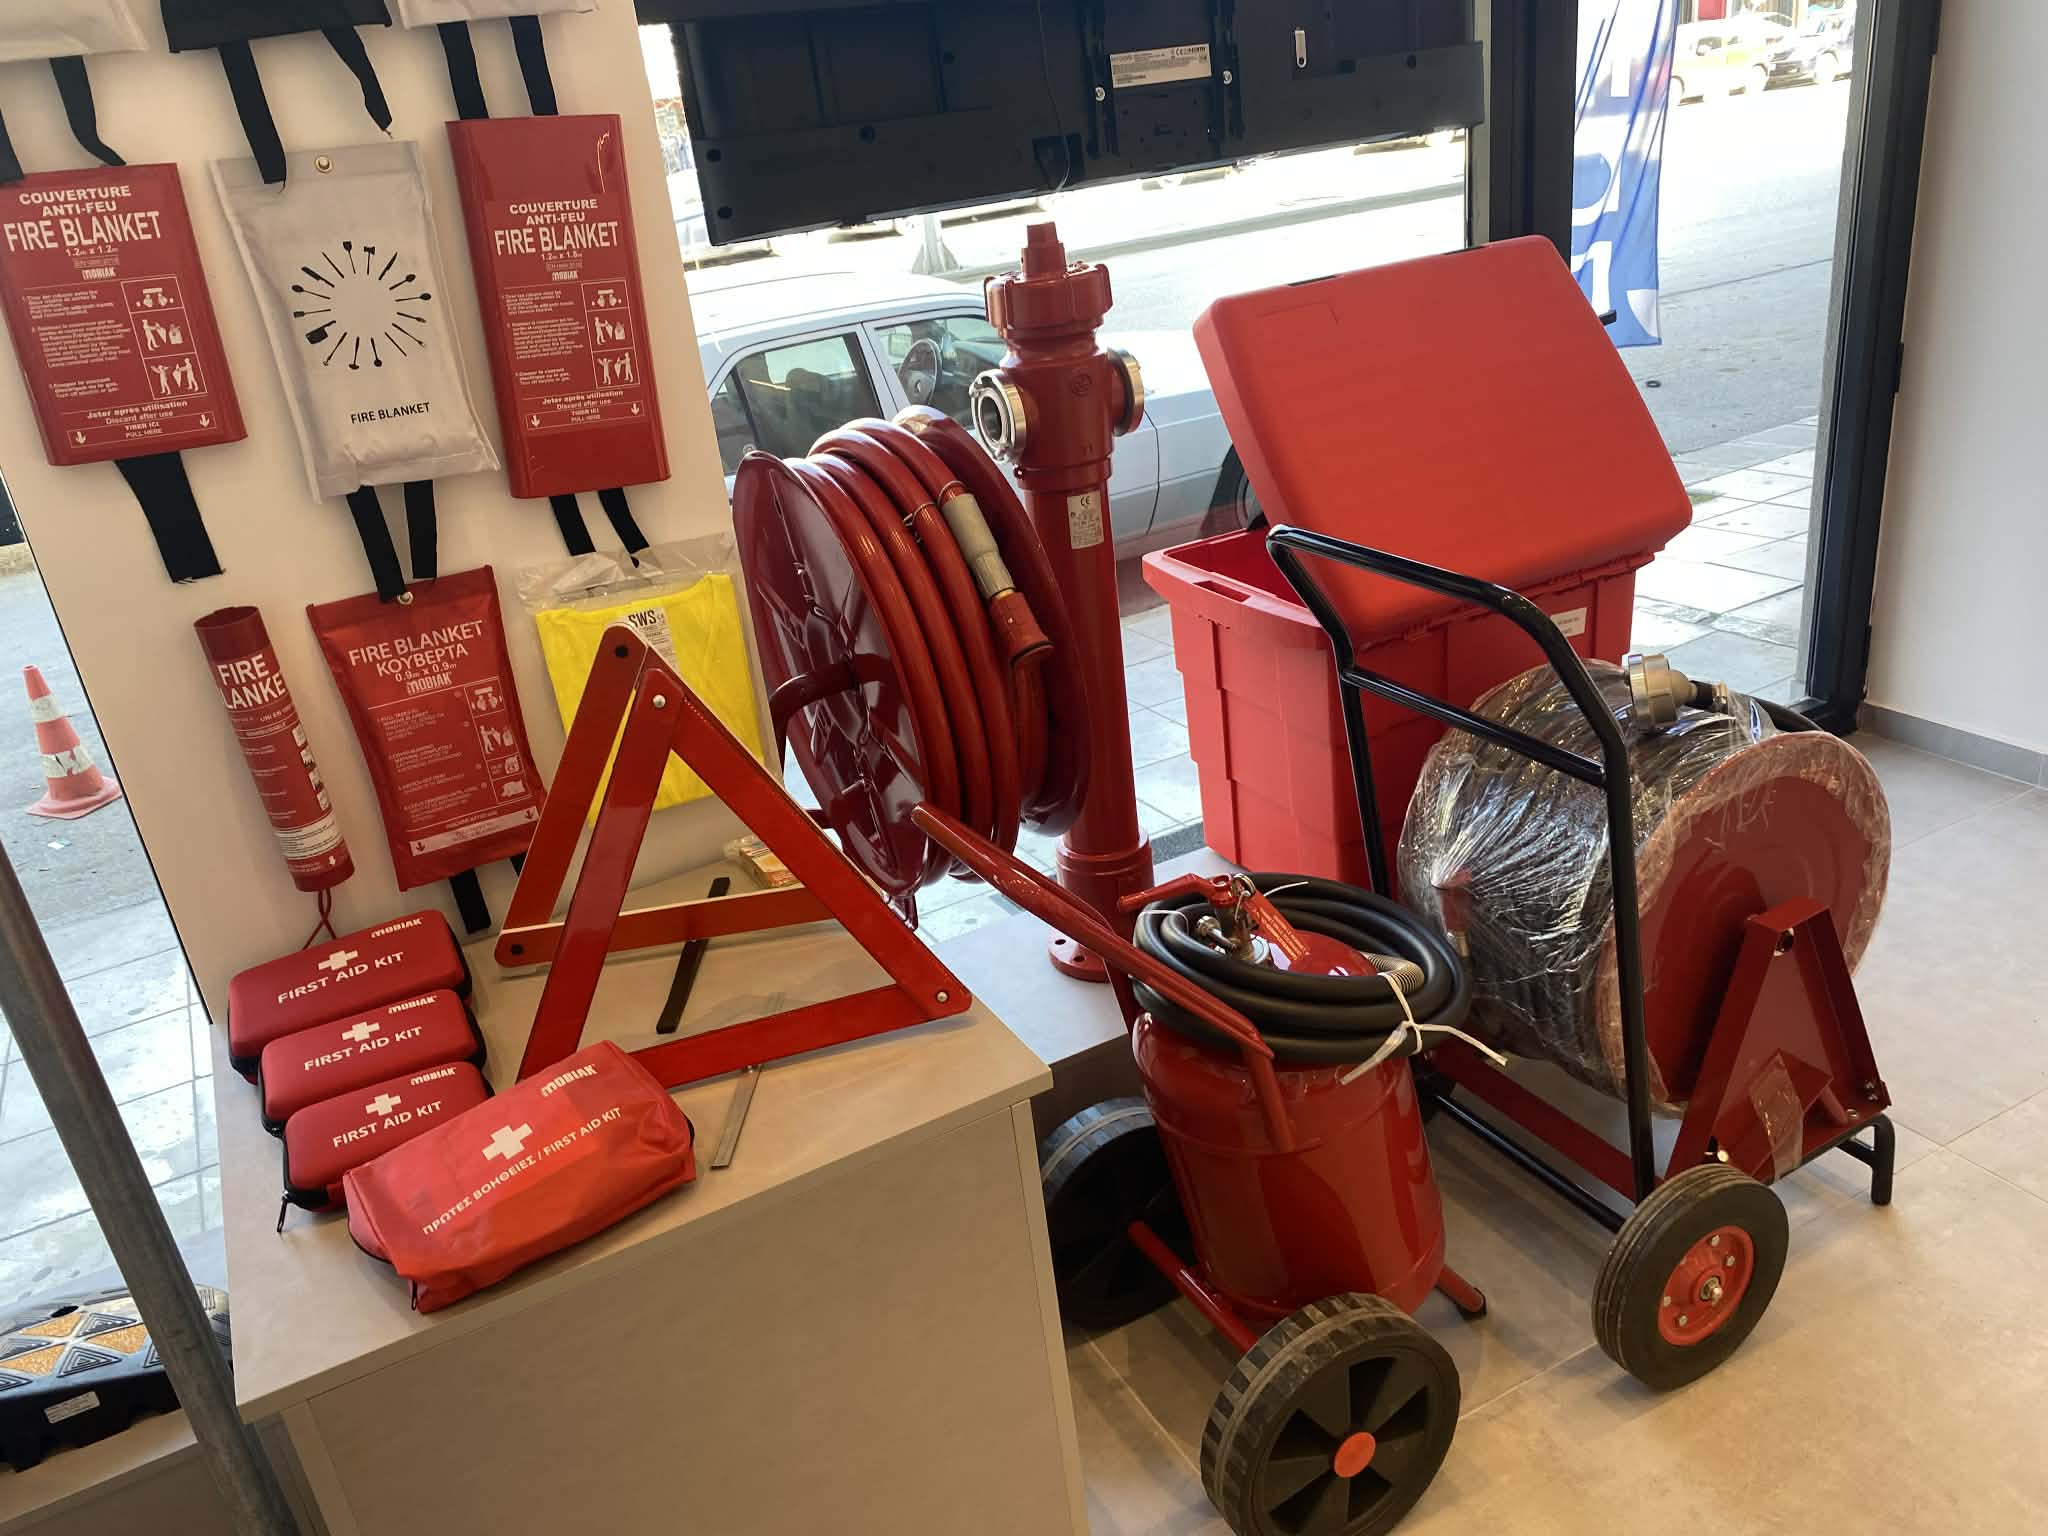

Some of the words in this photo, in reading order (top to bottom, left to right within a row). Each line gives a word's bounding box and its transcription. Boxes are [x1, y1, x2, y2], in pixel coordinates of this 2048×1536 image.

[19, 185, 131, 205] COUVERTURE
[42, 200, 117, 217] ANTI-FEU
[509, 199, 598, 214] COUVERTURE
[3, 219, 59, 252] FIRE
[60, 211, 160, 248] BLANKET
[526, 212, 585, 225] ANTI-FEU
[494, 227, 535, 256] FIRE
[538, 221, 619, 254] BLANKET
[351, 410, 377, 425] FIRE
[378, 402, 431, 420] BLANKET
[628, 610, 657, 628] SWS
[349, 642, 393, 666] FIRE
[394, 620, 482, 656] BLANKET
[376, 643, 469, 677] ΚΟΥΒΕΡΤΑ
[217, 653, 270, 686] FIRE
[219, 672, 286, 710] LANKE
[277, 976, 329, 1004] FIRST
[335, 963, 369, 982] AID
[374, 951, 404, 968] KIT
[304, 1047, 353, 1070] FIRST
[359, 1037, 390, 1053] AID
[394, 1026, 422, 1042] KIT
[333, 1122, 377, 1148] FIRST
[383, 1112, 412, 1129] AID
[416, 1101, 442, 1117] KIT
[423, 1196, 473, 1235] ΠΡΩΤΕΣ
[472, 1155, 537, 1200] ΒΟΗΘΕΙΕΣ
[543, 1131, 577, 1156] FIRST
[580, 1119, 602, 1136] AID
[602, 1107, 622, 1122] KIT
